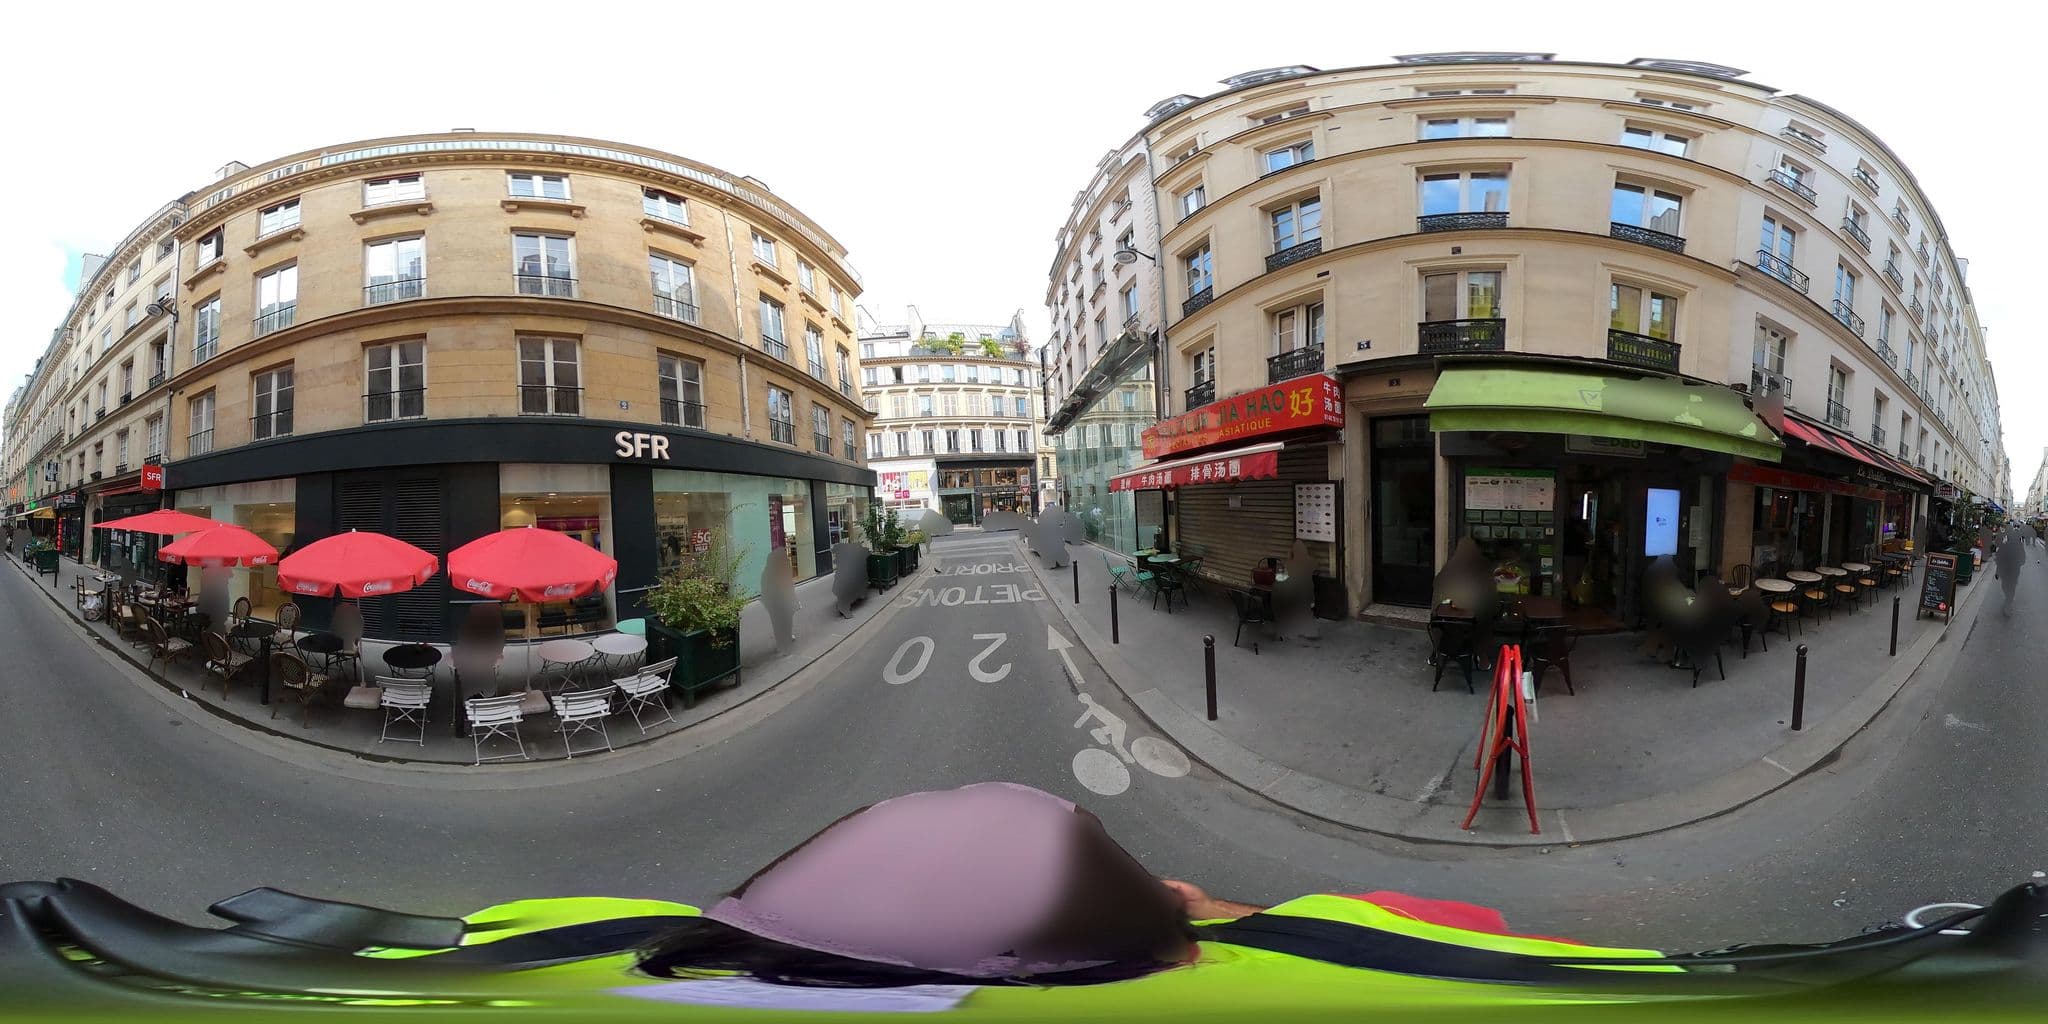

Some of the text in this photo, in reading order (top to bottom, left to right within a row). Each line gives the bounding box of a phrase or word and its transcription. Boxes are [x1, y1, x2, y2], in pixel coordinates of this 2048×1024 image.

[1217, 403, 1239, 425] JIA
[1246, 389, 1286, 416] HAO
[1290, 387, 1314, 418] 好
[1217, 417, 1272, 437] ASIATIQUE
[615, 431, 671, 460] SFR
[146, 472, 161, 482] SFR
[696, 531, 711, 544] 5G
[898, 583, 1048, 608] PIETONS
